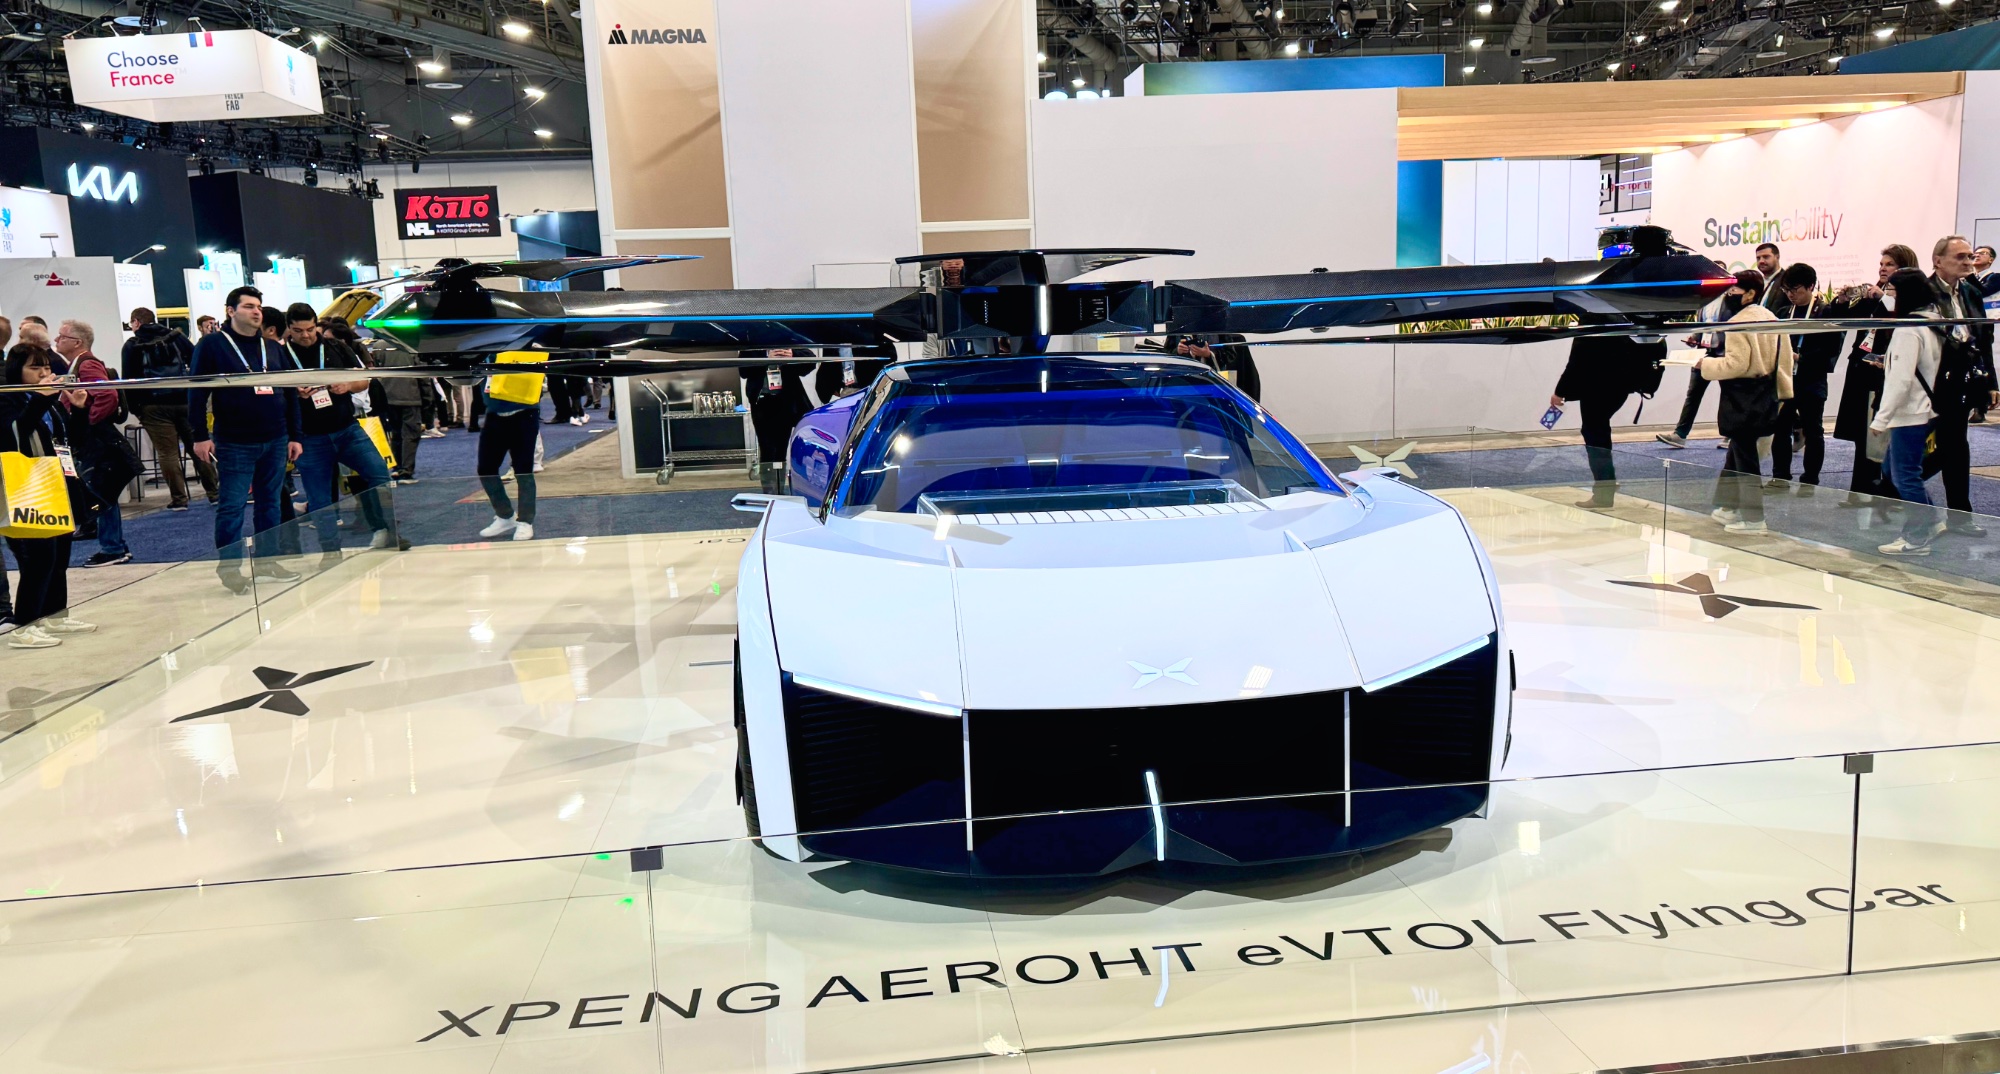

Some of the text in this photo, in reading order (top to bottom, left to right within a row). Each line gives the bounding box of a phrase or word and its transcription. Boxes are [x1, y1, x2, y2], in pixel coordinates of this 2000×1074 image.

[630, 28, 707, 45] MAGNA
[107, 51, 179, 68] Choose
[110, 71, 175, 88] France
[225, 100, 240, 111] FAB
[1703, 206, 1844, 248] Sustainability
[34, 273, 50, 281] geo
[62, 278, 80, 286] flex
[314, 397, 330, 405] TCL
[13, 507, 69, 526] Nikon
[417, 883, 1956, 1043] XPENG AEROHT eVTOL Flying Car
